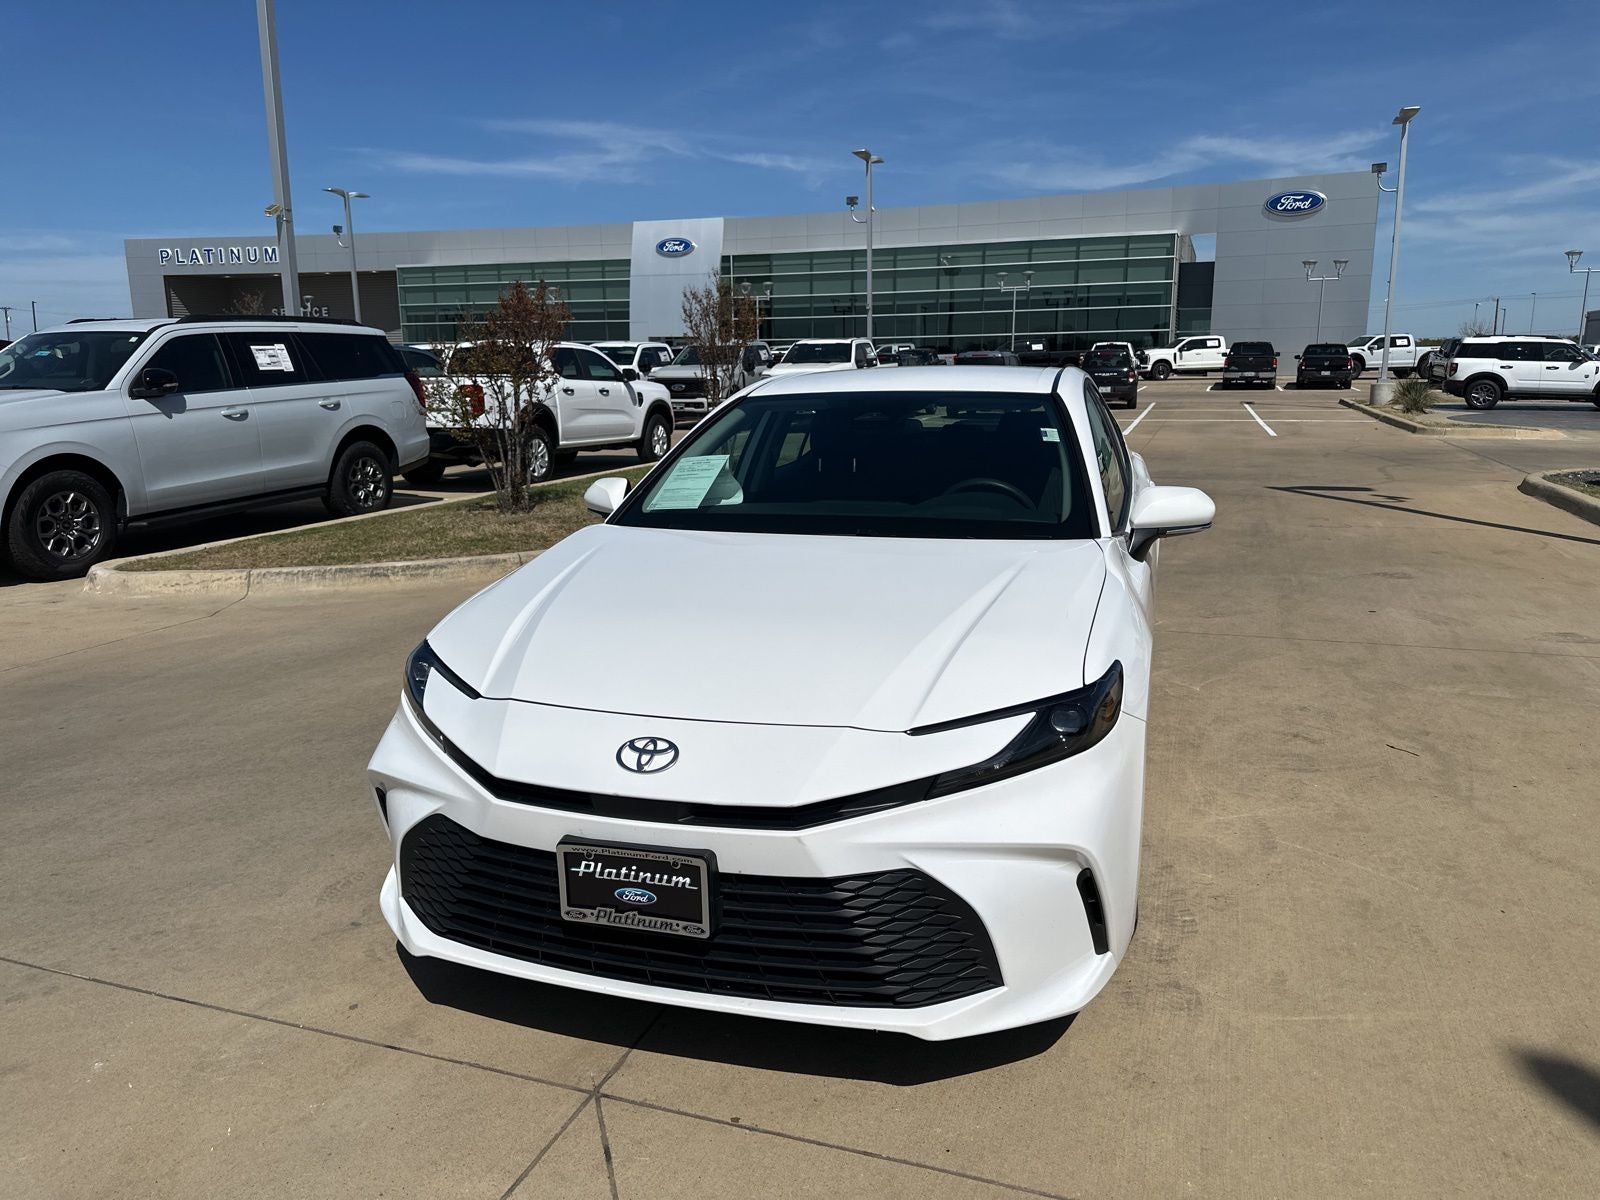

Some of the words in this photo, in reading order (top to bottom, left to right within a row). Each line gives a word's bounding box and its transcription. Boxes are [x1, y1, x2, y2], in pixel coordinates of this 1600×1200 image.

[1277, 195, 1313, 211] Ford
[663, 241, 685, 252] Ford
[158, 246, 279, 265] PLATINUM
[271, 306, 329, 317] SEICE
[571, 846, 694, 865] www.PlatinumFord.com
[570, 860, 699, 890] Platinum
[622, 889, 649, 903] Ford
[595, 909, 680, 932] Platinum
